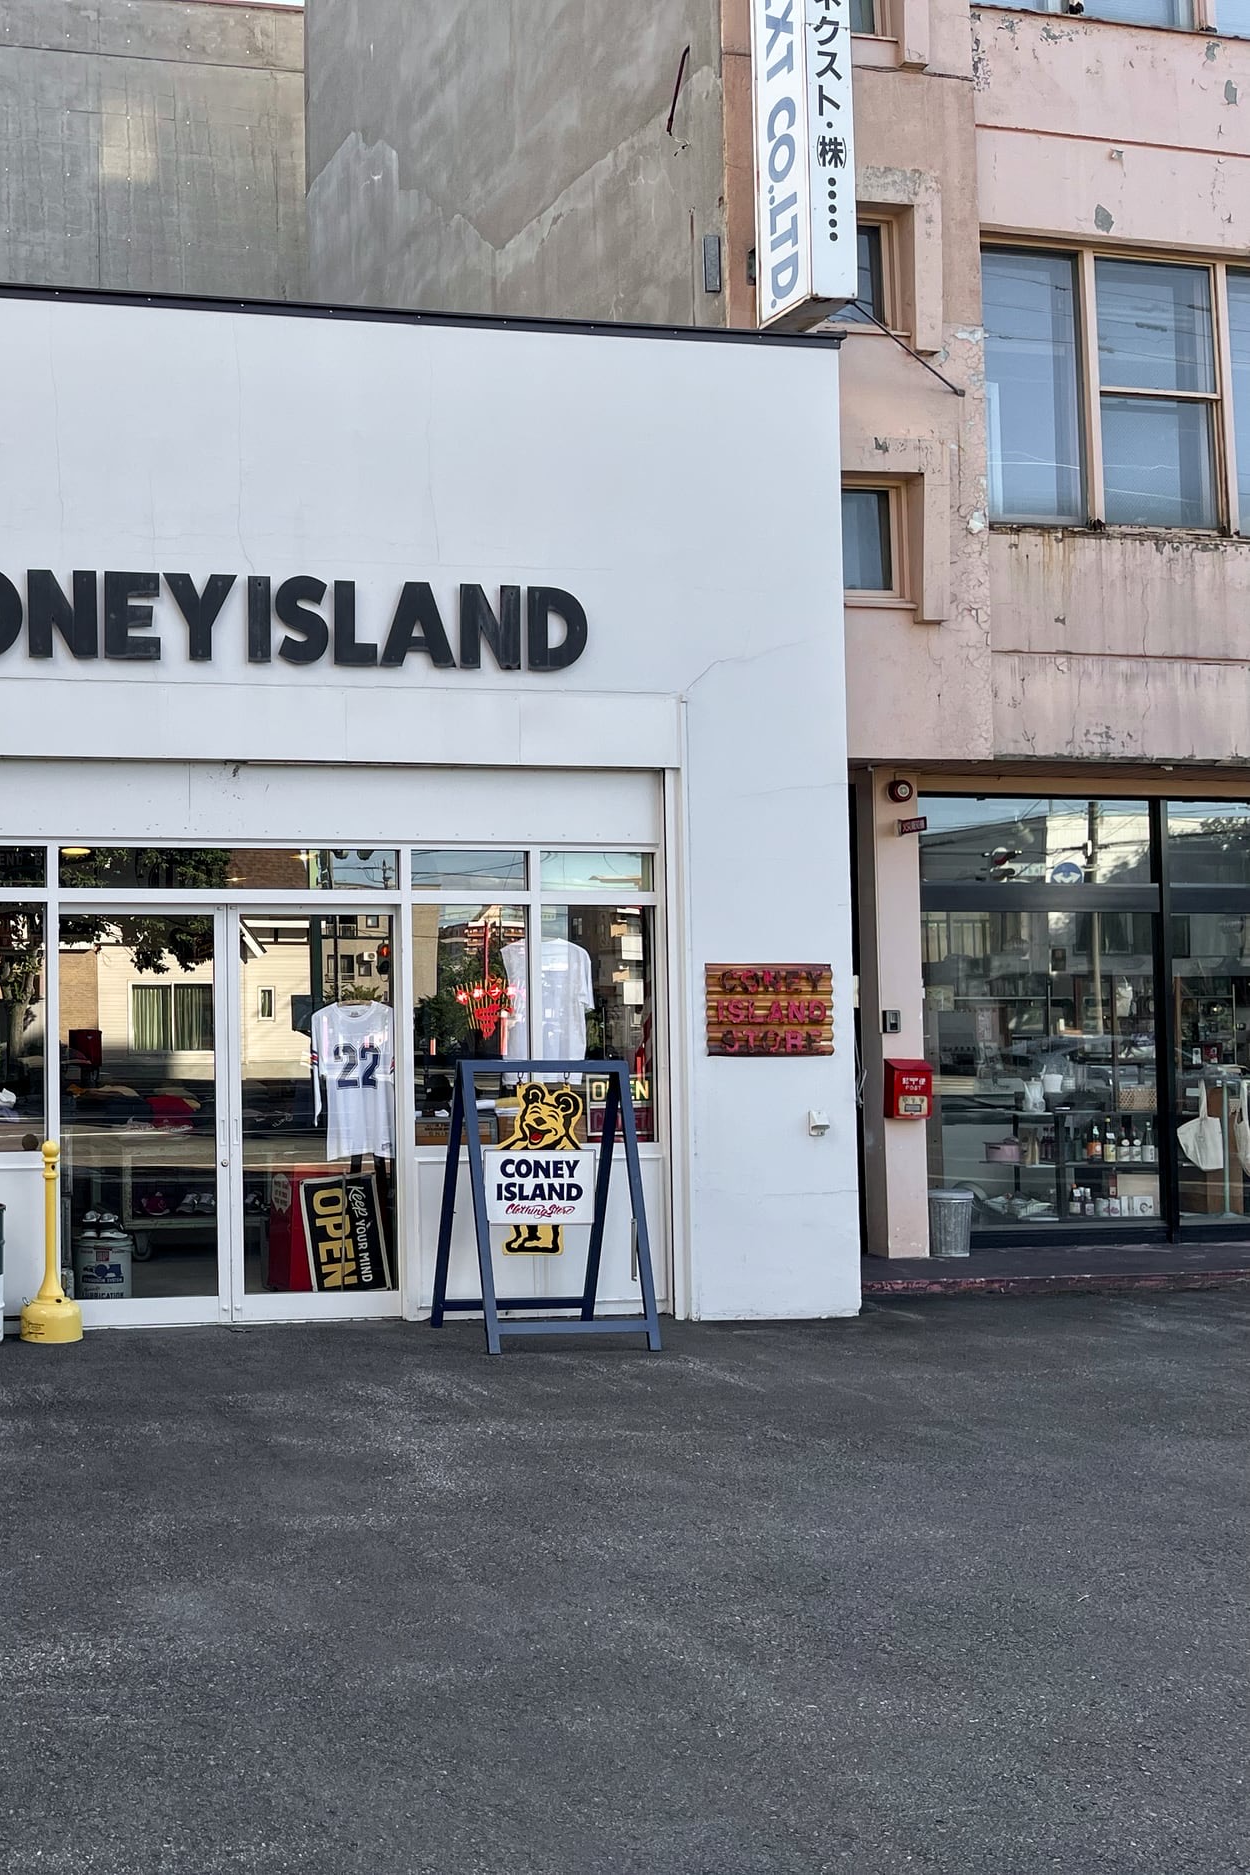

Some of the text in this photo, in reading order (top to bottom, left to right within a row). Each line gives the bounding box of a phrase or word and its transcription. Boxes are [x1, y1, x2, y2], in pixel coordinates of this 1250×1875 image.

[247, 574, 588, 672] ISLAND
[719, 970, 823, 993] CONEY
[717, 999, 827, 1023] ISLAND
[722, 1030, 822, 1053] STORE
[333, 1043, 382, 1090] 22
[500, 1158, 580, 1179] CONEY
[496, 1182, 583, 1202] ISLAND
[505, 1203, 576, 1219] Clothing Store
[313, 1188, 358, 1288] OPEN
[355, 1219, 373, 1250] YOUR
[358, 1252, 374, 1283] MIND
